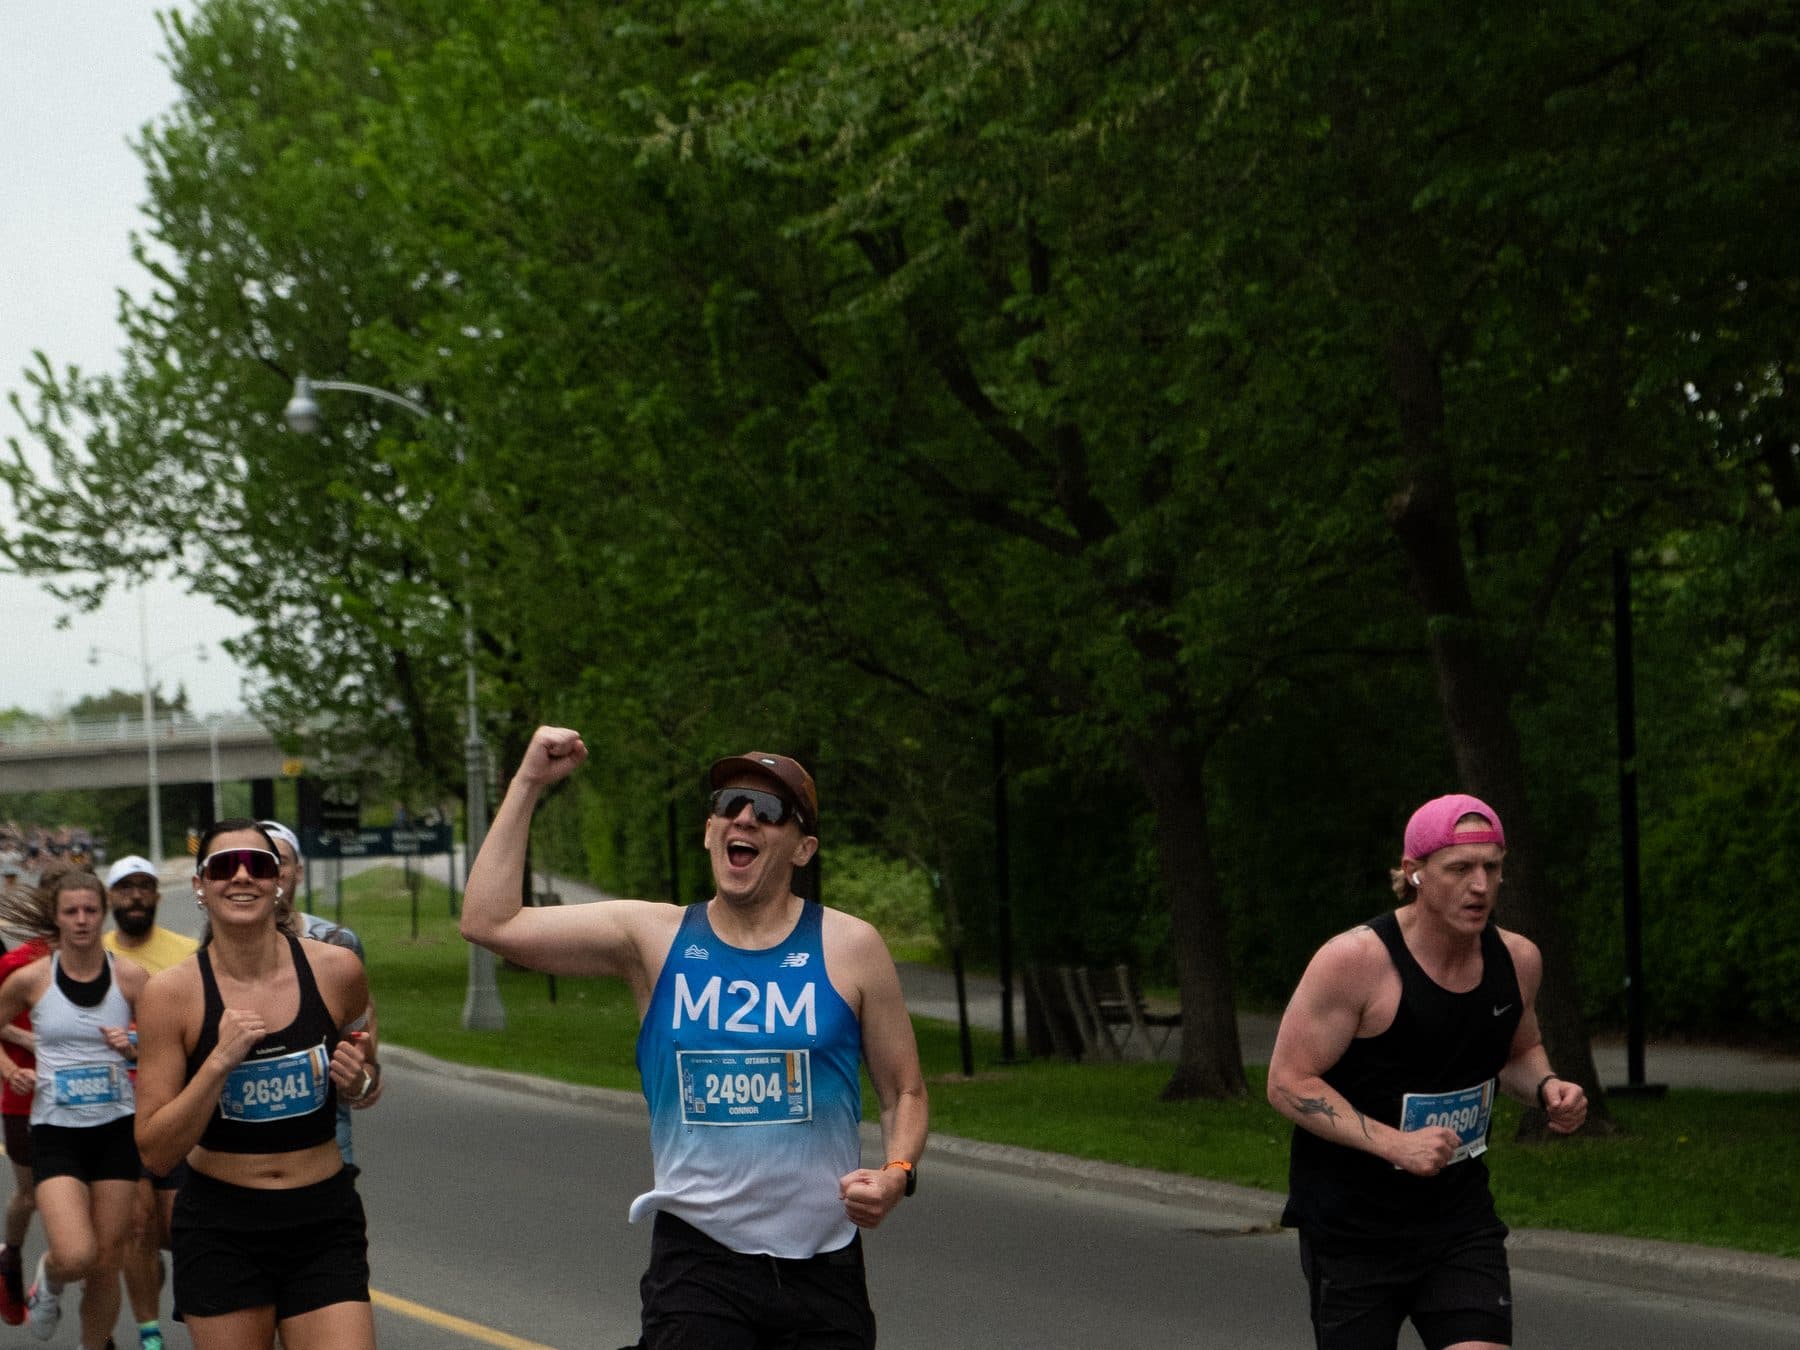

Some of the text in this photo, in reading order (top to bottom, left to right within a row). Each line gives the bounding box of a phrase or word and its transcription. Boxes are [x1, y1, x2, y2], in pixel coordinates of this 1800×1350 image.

[672, 973, 817, 1036] M2M
[242, 1071, 311, 1106] 26341
[705, 1072, 783, 1104] 24904
[728, 1106, 759, 1115] CONNOR
